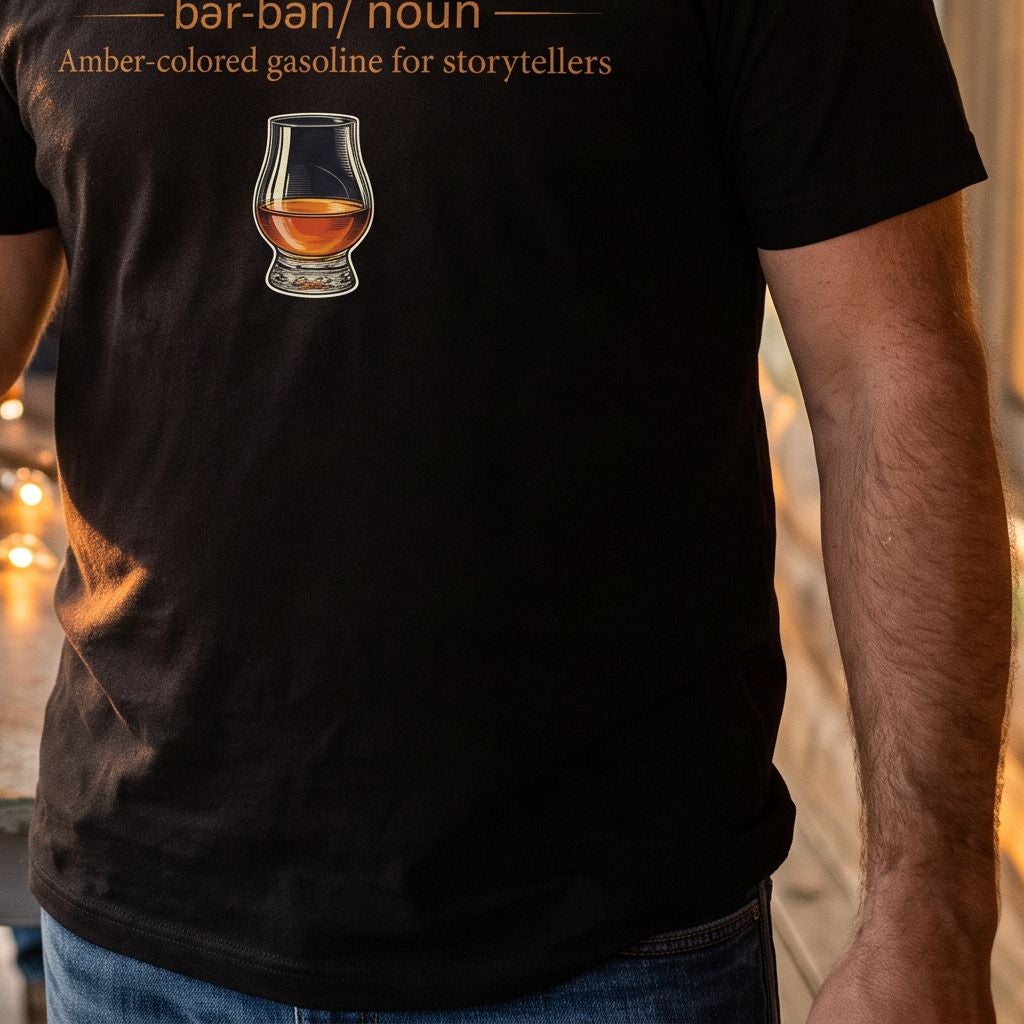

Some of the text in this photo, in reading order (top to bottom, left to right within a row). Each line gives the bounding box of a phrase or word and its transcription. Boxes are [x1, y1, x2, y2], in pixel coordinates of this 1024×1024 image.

[367, 0, 481, 30] noun
[58, 45, 613, 83] Amber-colored gasoline for storytellers
